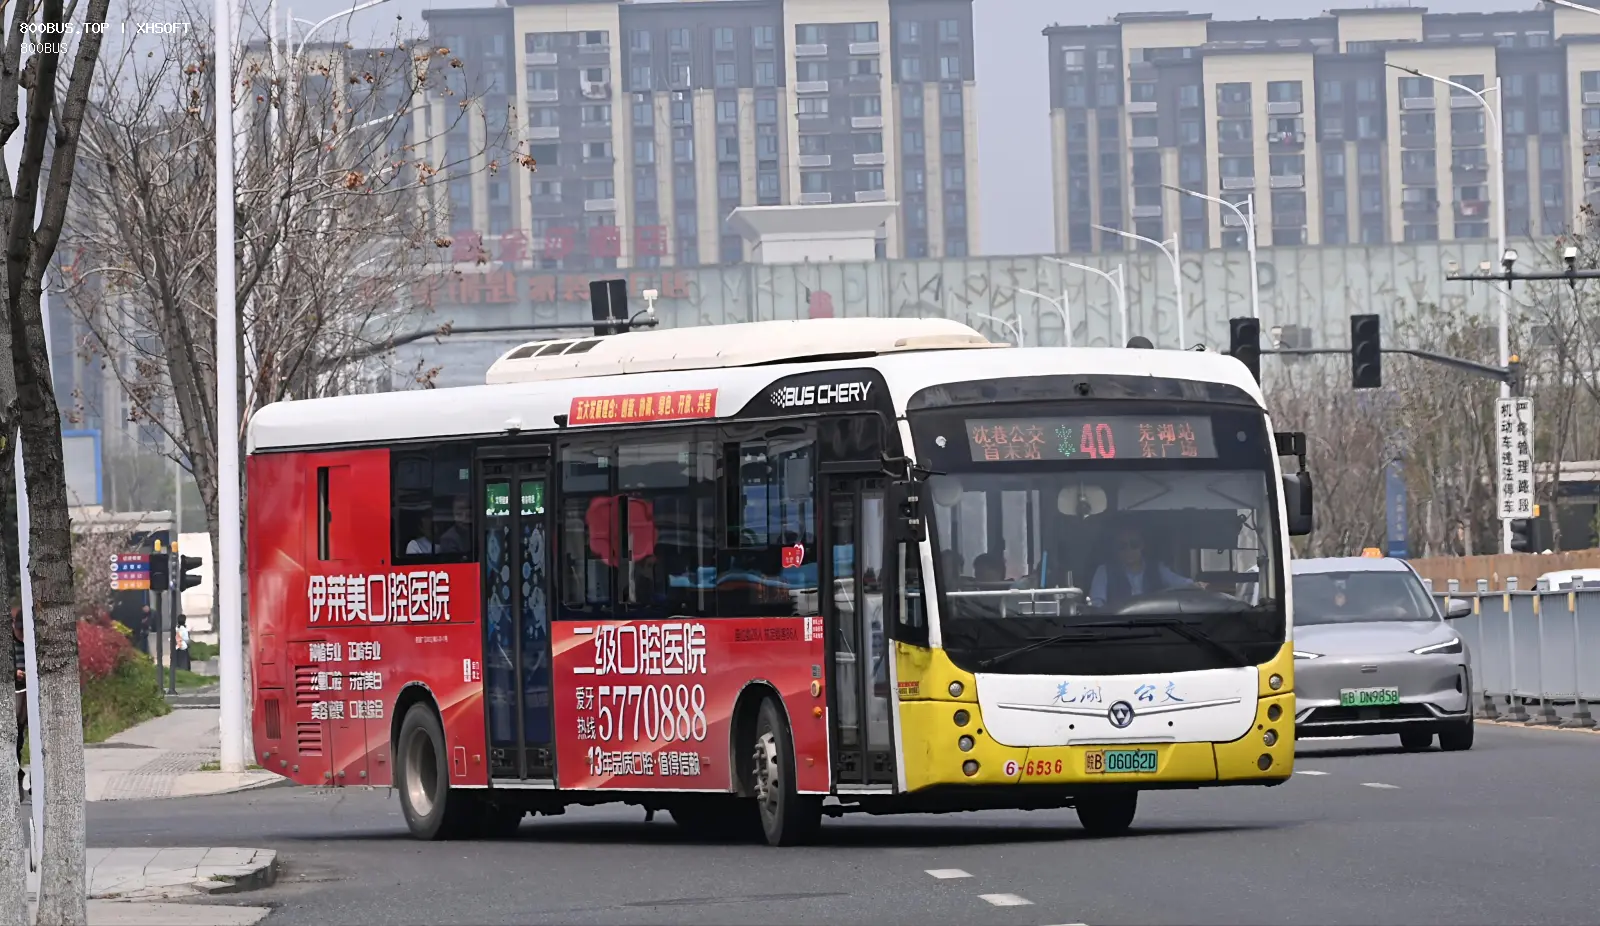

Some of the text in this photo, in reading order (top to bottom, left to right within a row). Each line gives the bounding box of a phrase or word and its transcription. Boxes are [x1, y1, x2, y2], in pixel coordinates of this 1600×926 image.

[784, 380, 873, 407] BUS CHERY
[972, 424, 1046, 444] 沈巷公交
[1079, 423, 1116, 459] 40
[1137, 422, 1196, 442] 芜湖站
[981, 442, 1042, 460] 首末站
[1140, 441, 1198, 458] 东广场
[1501, 403, 1515, 514] 机动车违法停车
[307, 570, 451, 623] 伊莱美口腔医院
[347, 640, 382, 661] 正畸专业
[573, 622, 707, 675] 二级口腔医院
[574, 686, 595, 710] 爱牙
[1052, 680, 1184, 705] 芜湖 公交
[598, 683, 707, 742] 5770888
[576, 716, 597, 740] 热线
[1005, 758, 1063, 776] 6-6536
[1108, 753, 1156, 770] 06062D
